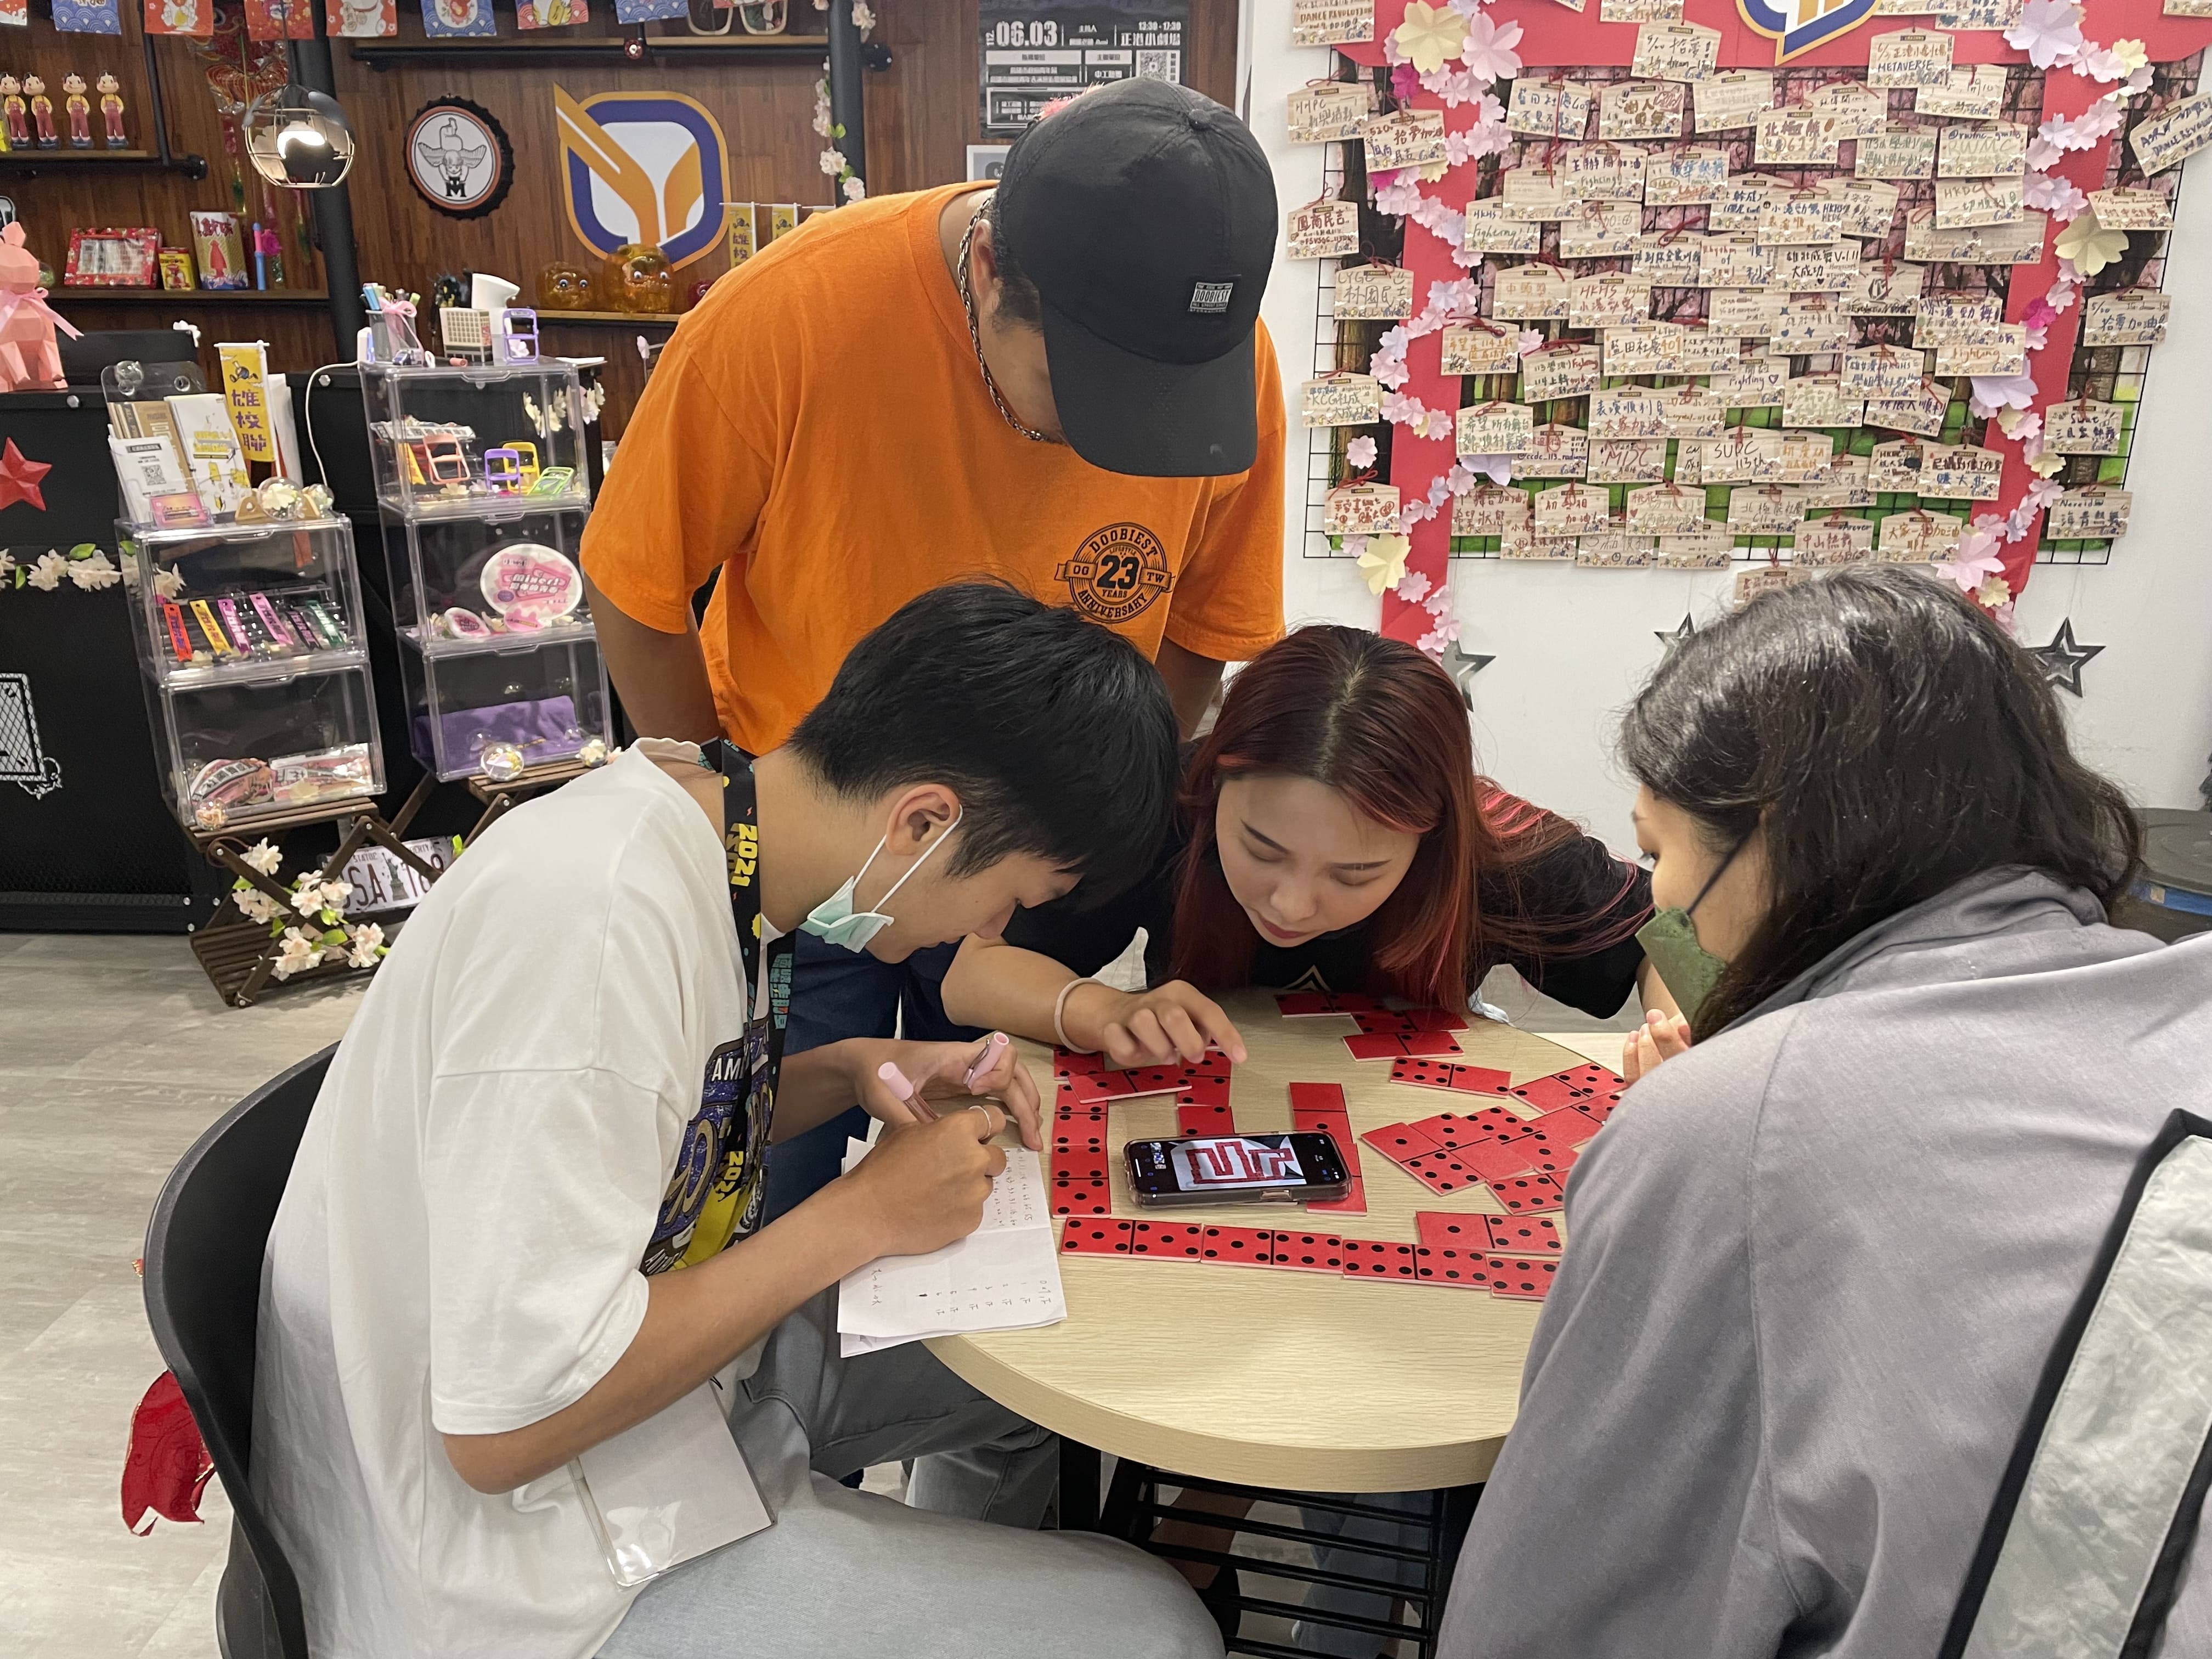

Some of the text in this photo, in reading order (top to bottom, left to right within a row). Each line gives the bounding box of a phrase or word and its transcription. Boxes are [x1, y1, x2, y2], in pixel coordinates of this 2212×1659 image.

[996, 20, 1058, 47] 06.03
[1878, 60, 1934, 72] METAVERSE
[1579, 284, 1617, 300] HKHS
[231, 388, 267, 452] 雄校聯
[1088, 528, 1158, 557] DOOBIEST
[1096, 554, 1140, 590] 23
[1147, 572, 1166, 584] TW
[1077, 589, 1148, 619] ANNIVERSARY
[1102, 589, 1128, 599] YEARS
[730, 823, 758, 887] 2021
